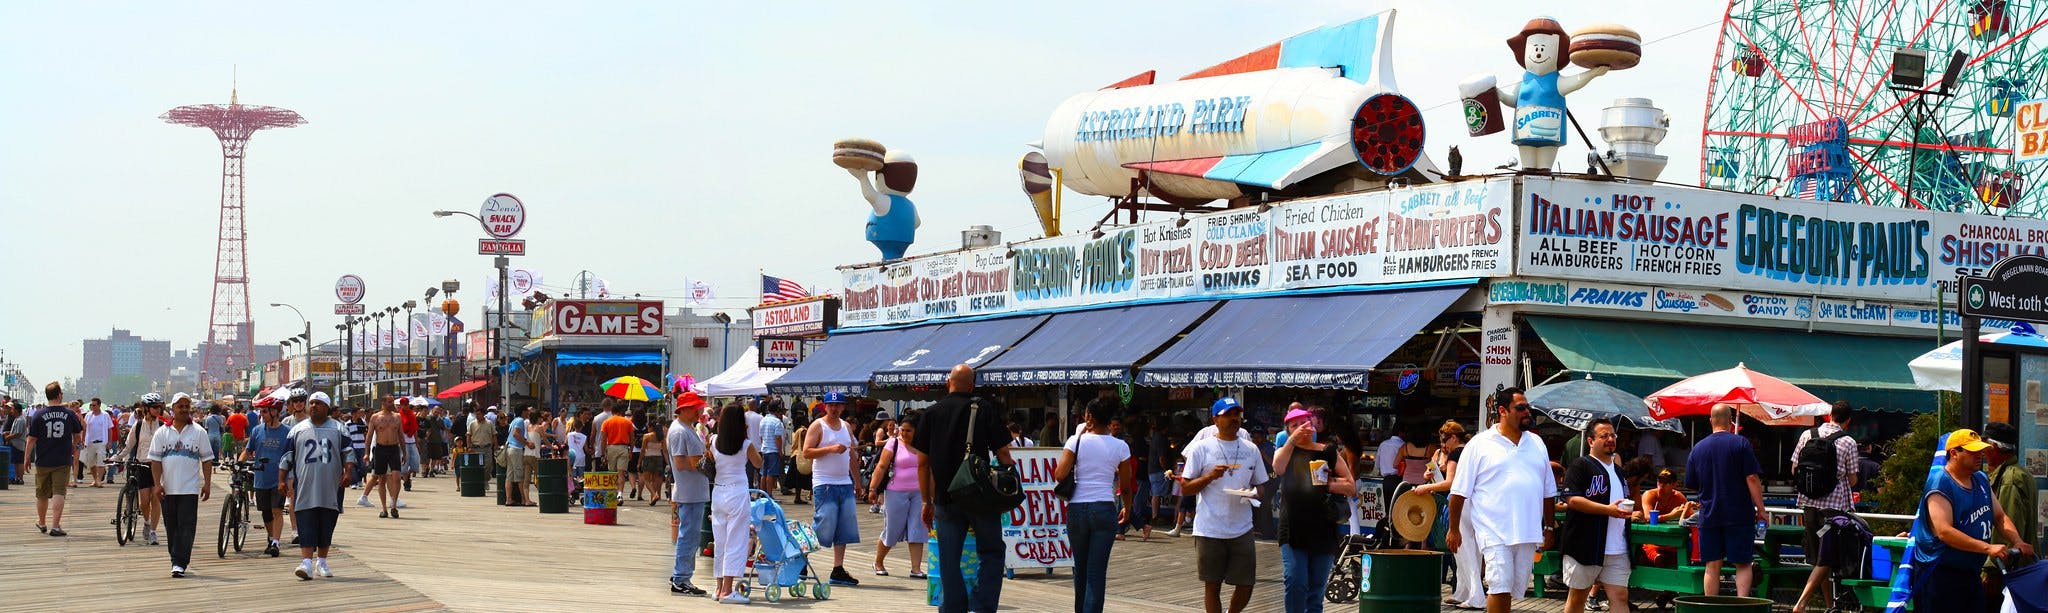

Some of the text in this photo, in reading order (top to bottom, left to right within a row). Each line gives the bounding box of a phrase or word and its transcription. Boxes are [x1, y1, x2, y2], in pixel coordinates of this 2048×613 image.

[1075, 96, 1252, 141] ASTROLAND PARK
[1518, 108, 1561, 129] SABRETT
[1788, 118, 1838, 147] WONDER
[1787, 150, 1831, 176] WHEEL
[1400, 192, 1440, 215] SABRETT
[1612, 194, 1656, 212] HOT
[490, 215, 516, 223] SNACK
[1208, 212, 1260, 227] FRIED SHRIMPS
[1285, 203, 1363, 226] Fried Chicken
[1530, 193, 1730, 249] ITALIAN SAUSAGE
[1143, 226, 1191, 243] Hot Knishes
[1206, 226, 1225, 240] COLD
[1386, 207, 1502, 252] FRANKFURTERS
[1960, 223, 2023, 242] CHARCOAL
[1275, 216, 1380, 262] ITALIAN SAUSAGE
[1539, 238, 1618, 255] ALL BEEF
[1736, 203, 1929, 284] GREGORY & PAUL'S
[1140, 243, 1193, 276] HOT PIZZA
[1200, 234, 1268, 270] COLD BEER
[1472, 249, 1499, 258] FRENCH
[1640, 244, 1715, 261] HOT CORN
[1939, 235, 2009, 267] SHISH
[975, 254, 987, 269] Pop
[988, 252, 1004, 266] Corn
[1013, 229, 1135, 299] GREGORY & PAUL'S
[1383, 256, 1396, 265] ALL
[1398, 253, 1469, 275] HAMBURGERS
[1471, 260, 1497, 269] FRIES
[1530, 252, 1623, 270] HAMBURGERS
[1635, 257, 1722, 275] FRENCH FRIES
[898, 265, 912, 277] CORN
[1203, 269, 1261, 289] DRINKS
[1286, 261, 1357, 282] SEA FOOD
[1383, 266, 1396, 275] BEEF
[2002, 264, 2034, 281] RIEGELMANN
[921, 270, 963, 302] COLD BEER
[970, 295, 1005, 310] ICE CREAM
[1570, 288, 1647, 308] FRANKS
[1655, 289, 1699, 312] Sausage
[1742, 294, 1786, 305] COTTON
[1989, 290, 2041, 312] West 10th
[765, 305, 810, 326] ASTROLAND
[926, 300, 957, 314] DRINKS
[1748, 304, 1789, 316] CANDY
[1834, 304, 1848, 319] ICE
[1850, 305, 1887, 321] CREAM
[558, 305, 660, 334] GAMES
[1920, 310, 1960, 326] BEER
[1487, 326, 1511, 336] CHARCOAL
[771, 341, 794, 351] ATM
[1486, 345, 1511, 355] SHISH
[1486, 356, 1511, 365] Kabob
[1213, 372, 1222, 383] ALL
[1223, 372, 1233, 383] BEEF
[42, 411, 69, 421] VENTURA
[1558, 408, 1593, 419] BUD
[45, 420, 65, 438] 19
[1556, 417, 1590, 431] LIGH
[1361, 505, 1384, 521] Patties
[1024, 528, 1059, 539] ICE
